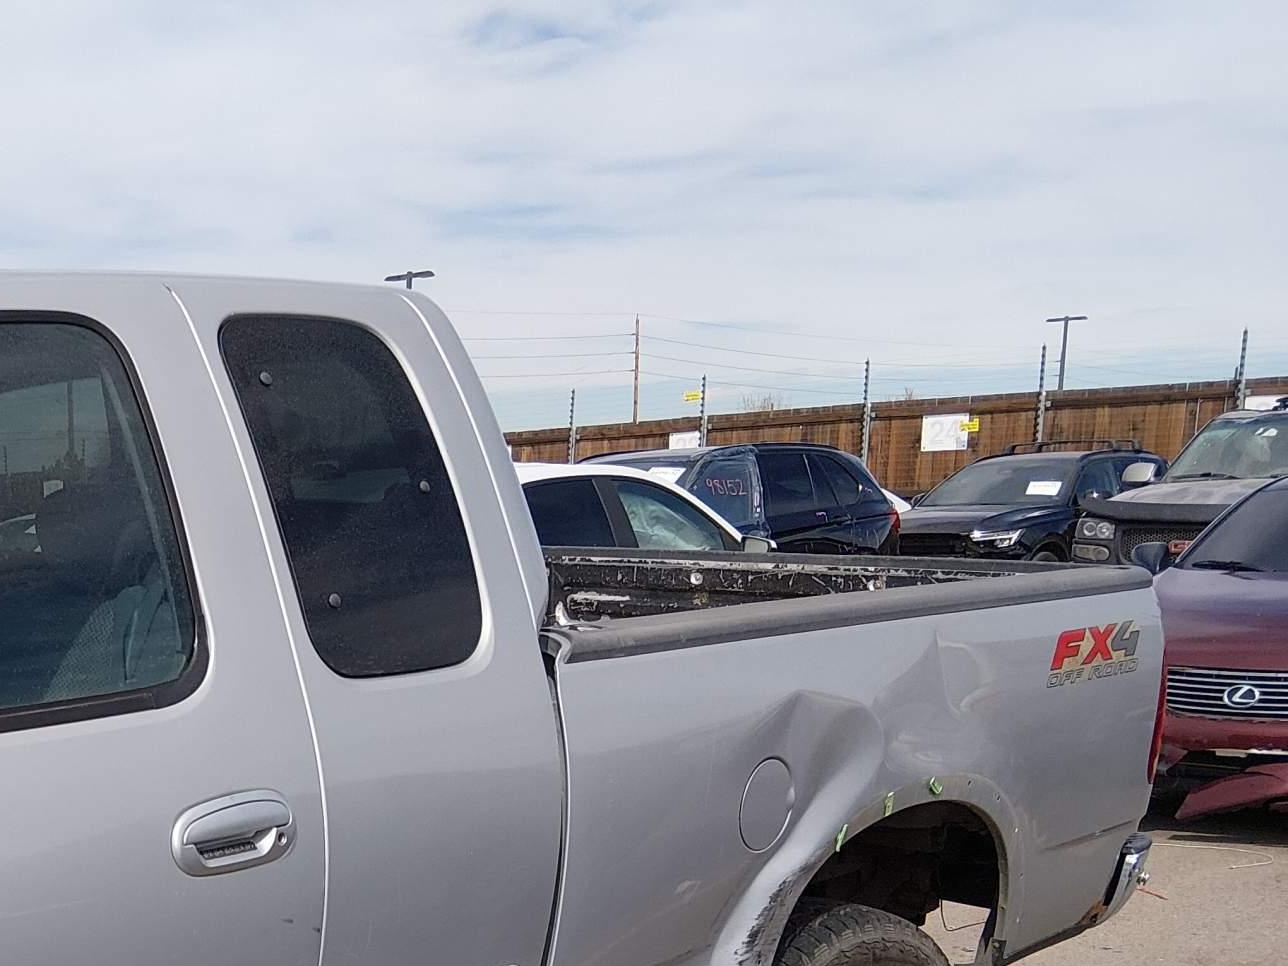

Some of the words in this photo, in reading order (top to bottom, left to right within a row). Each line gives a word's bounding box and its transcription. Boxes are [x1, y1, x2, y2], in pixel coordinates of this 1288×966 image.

[705, 478, 748, 497] 98152
[1050, 619, 1141, 671] FX4
[1047, 668, 1085, 688] OFF
[1088, 658, 1139, 680] ROAD
